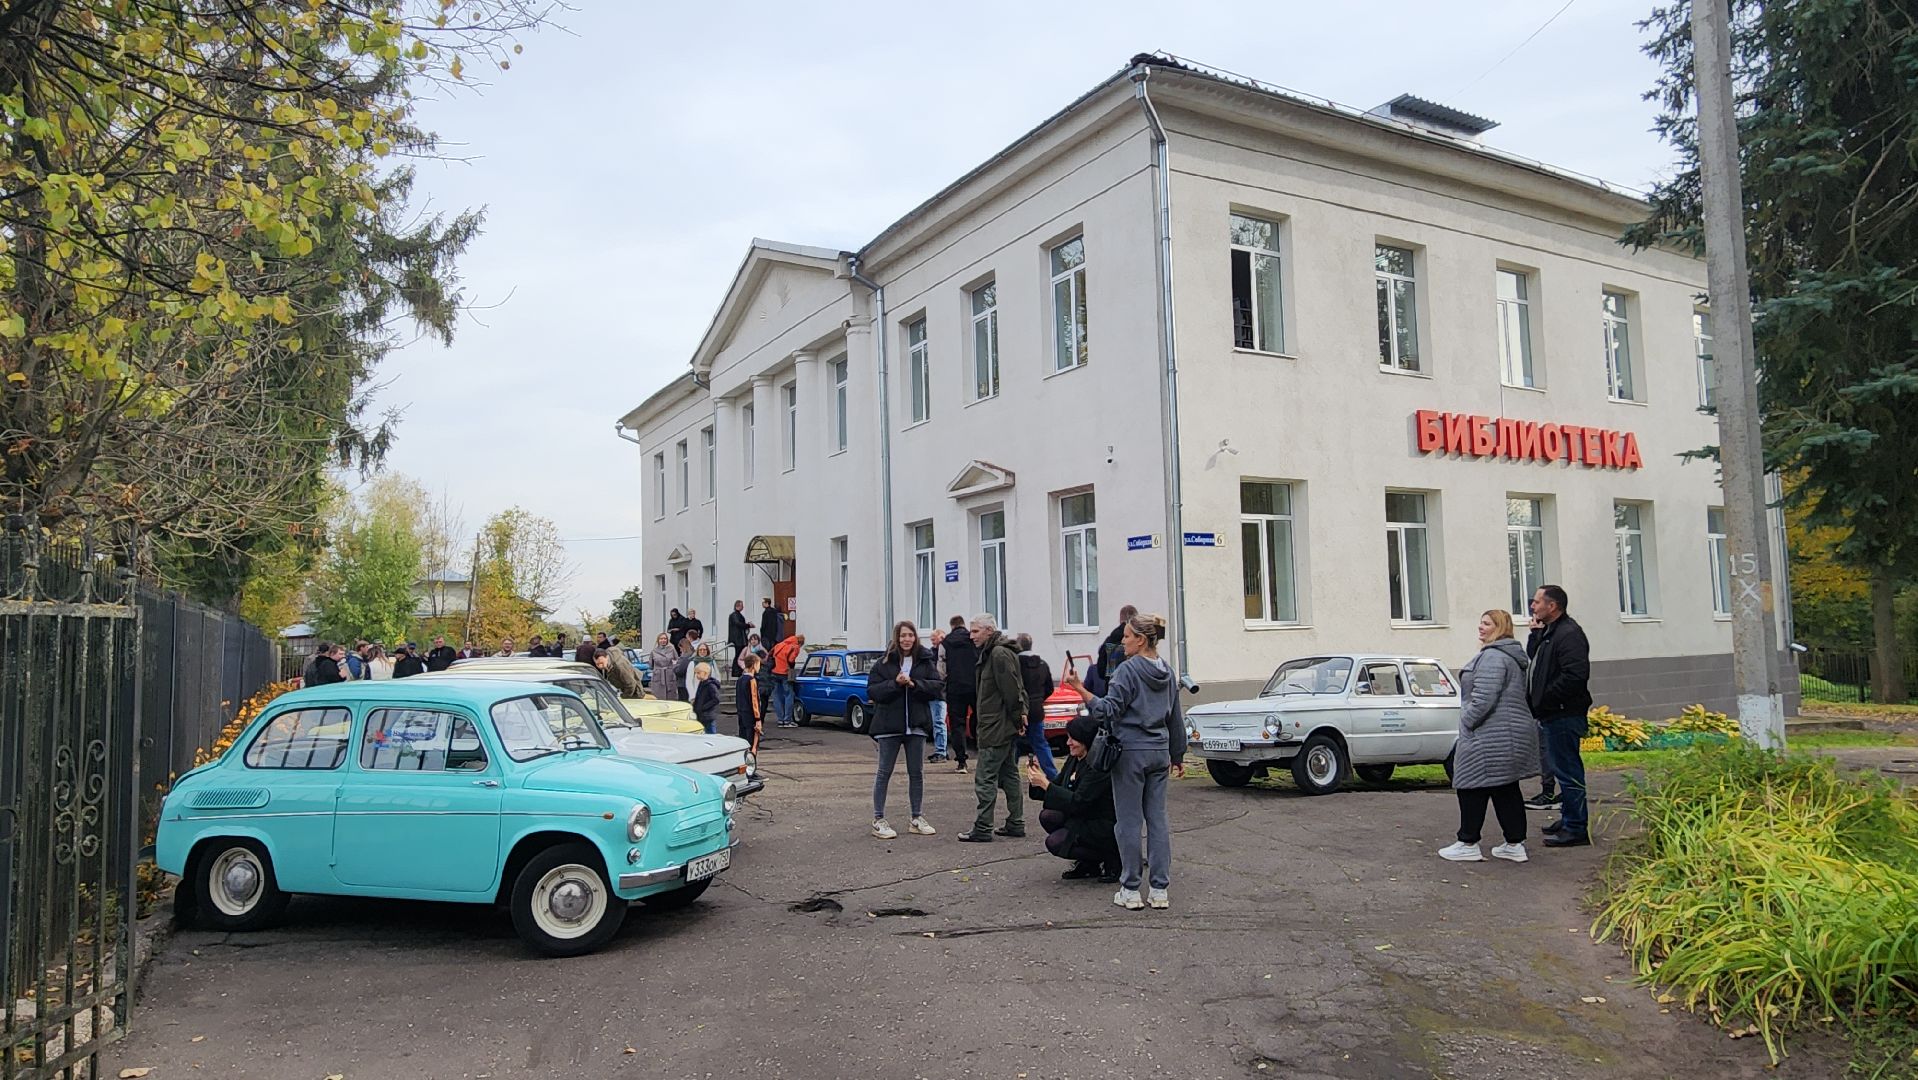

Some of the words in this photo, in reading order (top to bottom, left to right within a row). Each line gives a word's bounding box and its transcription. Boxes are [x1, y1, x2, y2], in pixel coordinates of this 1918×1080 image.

[1416, 409, 1643, 468] БИБЛИОТЕКА
[1153, 536, 1159, 546] 6
[1216, 535, 1222, 544] 6
[1730, 553, 1757, 576] 15
